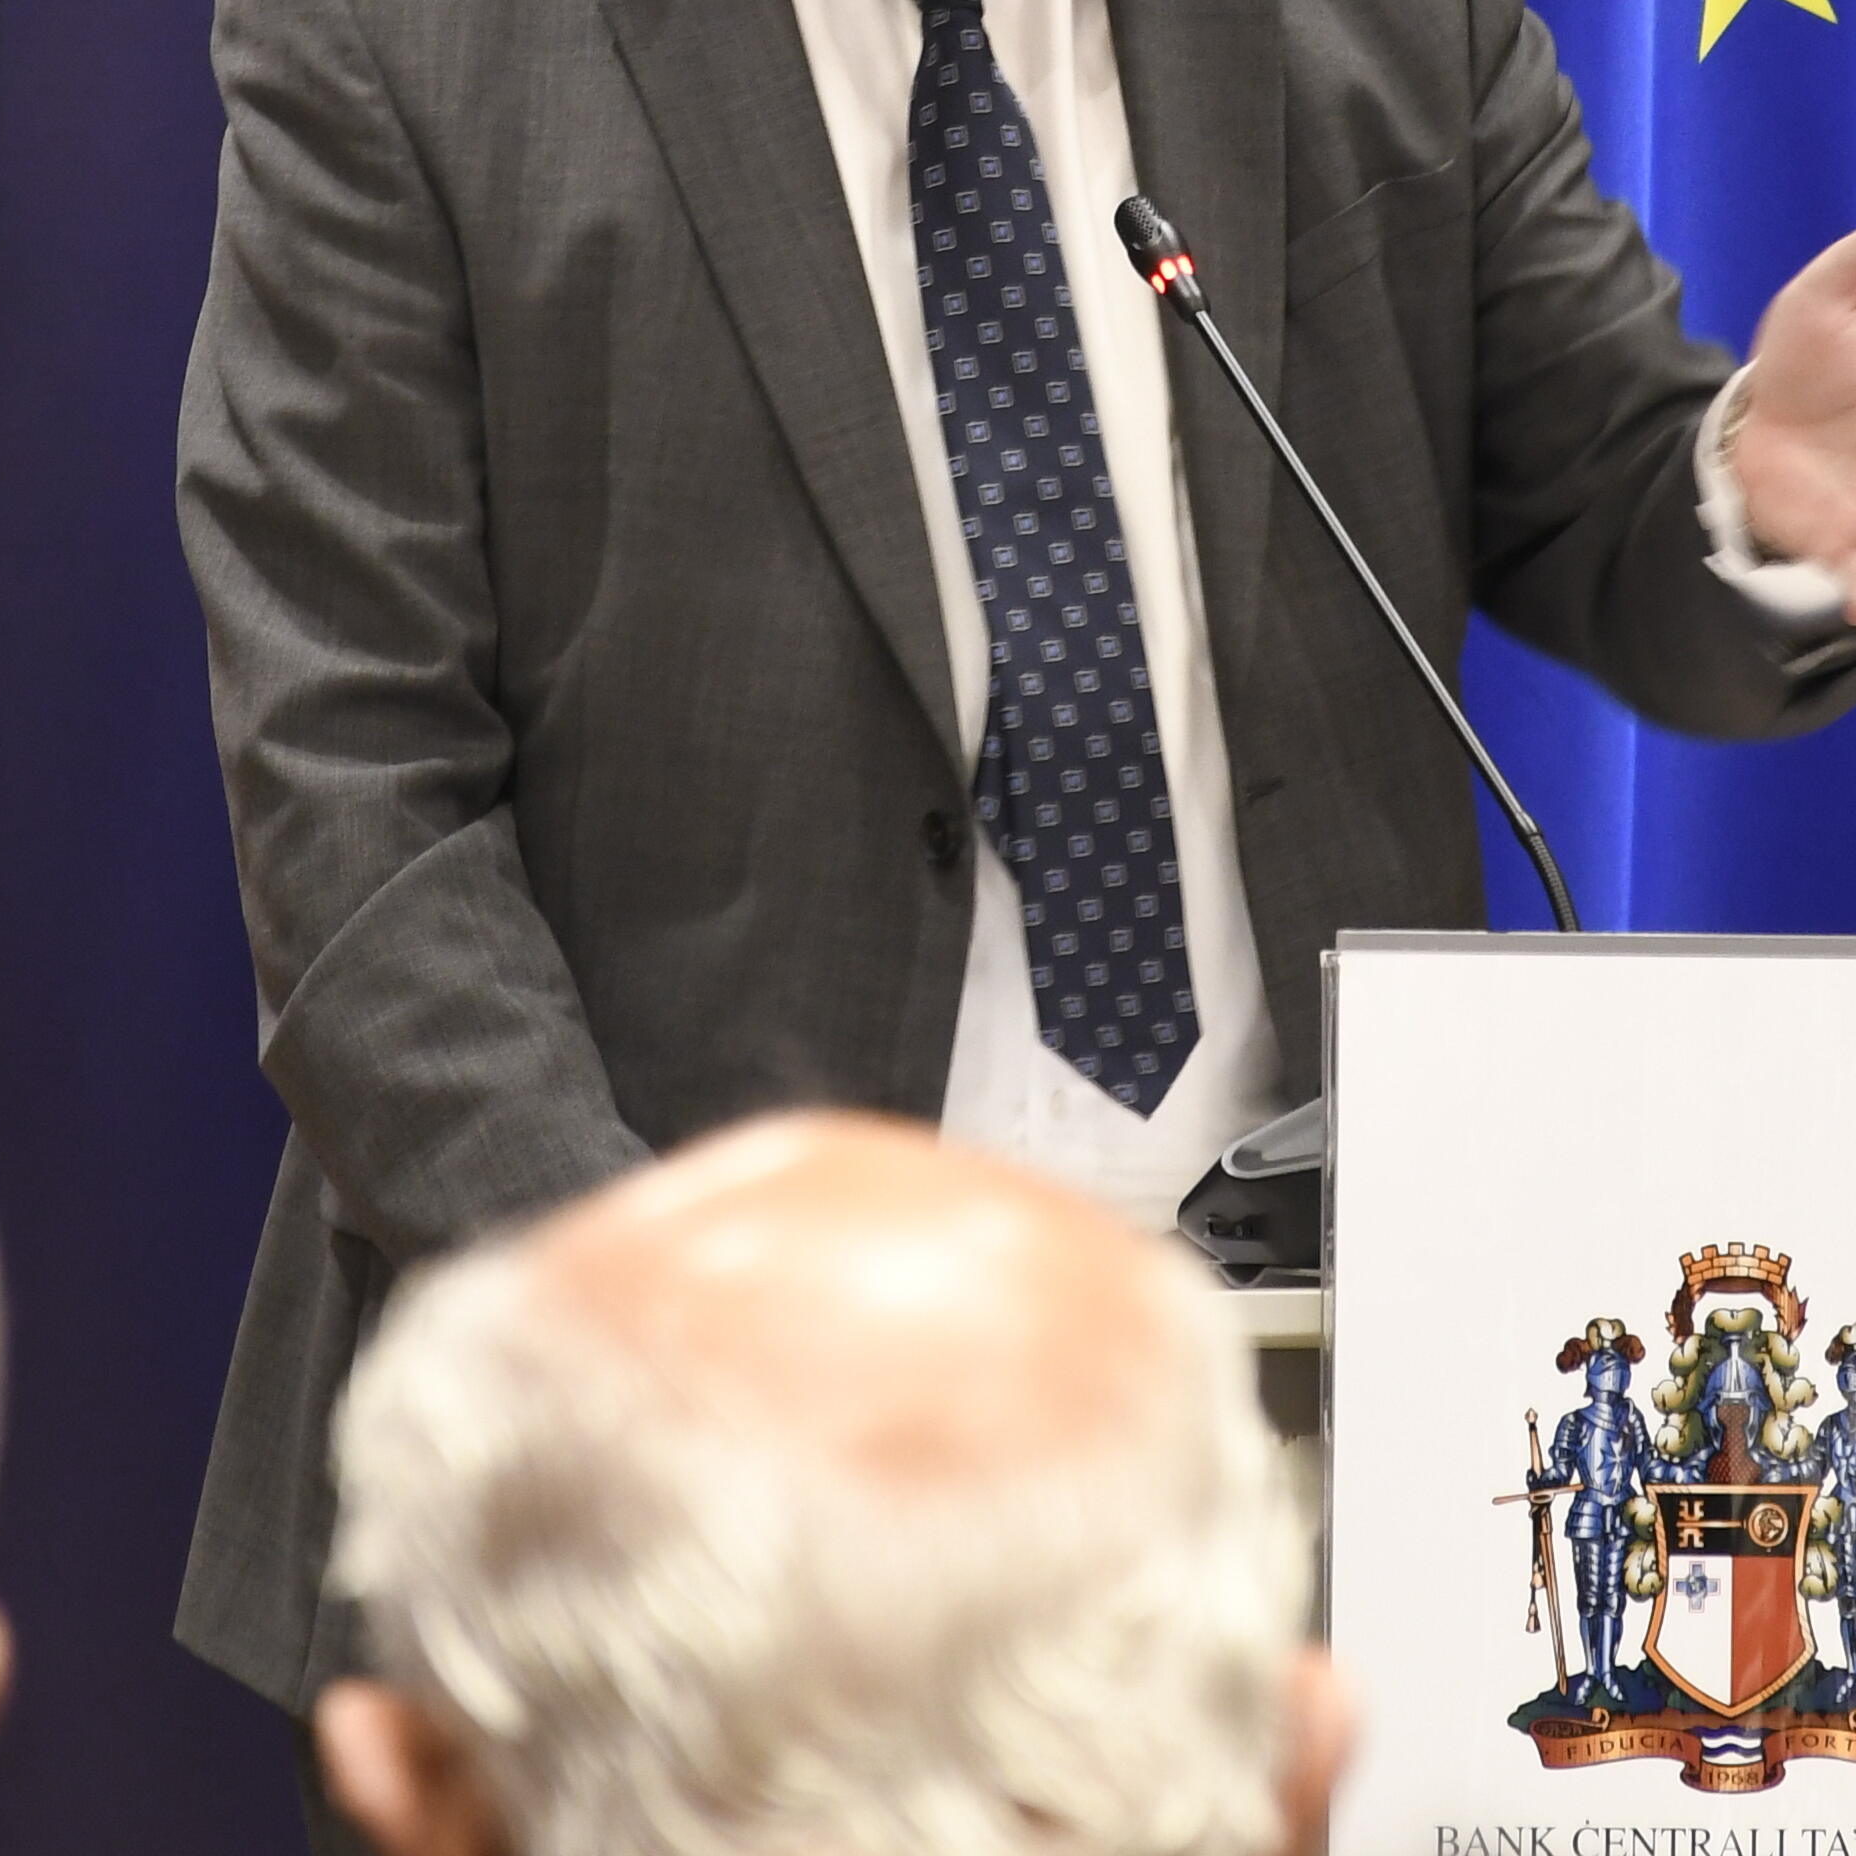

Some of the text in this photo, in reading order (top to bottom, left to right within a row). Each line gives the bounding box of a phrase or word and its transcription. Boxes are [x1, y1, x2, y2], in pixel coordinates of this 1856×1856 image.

[1566, 1735, 1685, 1760] FIDUCIA
[1707, 1768, 1760, 1786] 1968
[1434, 1826, 1557, 1856] BANK
